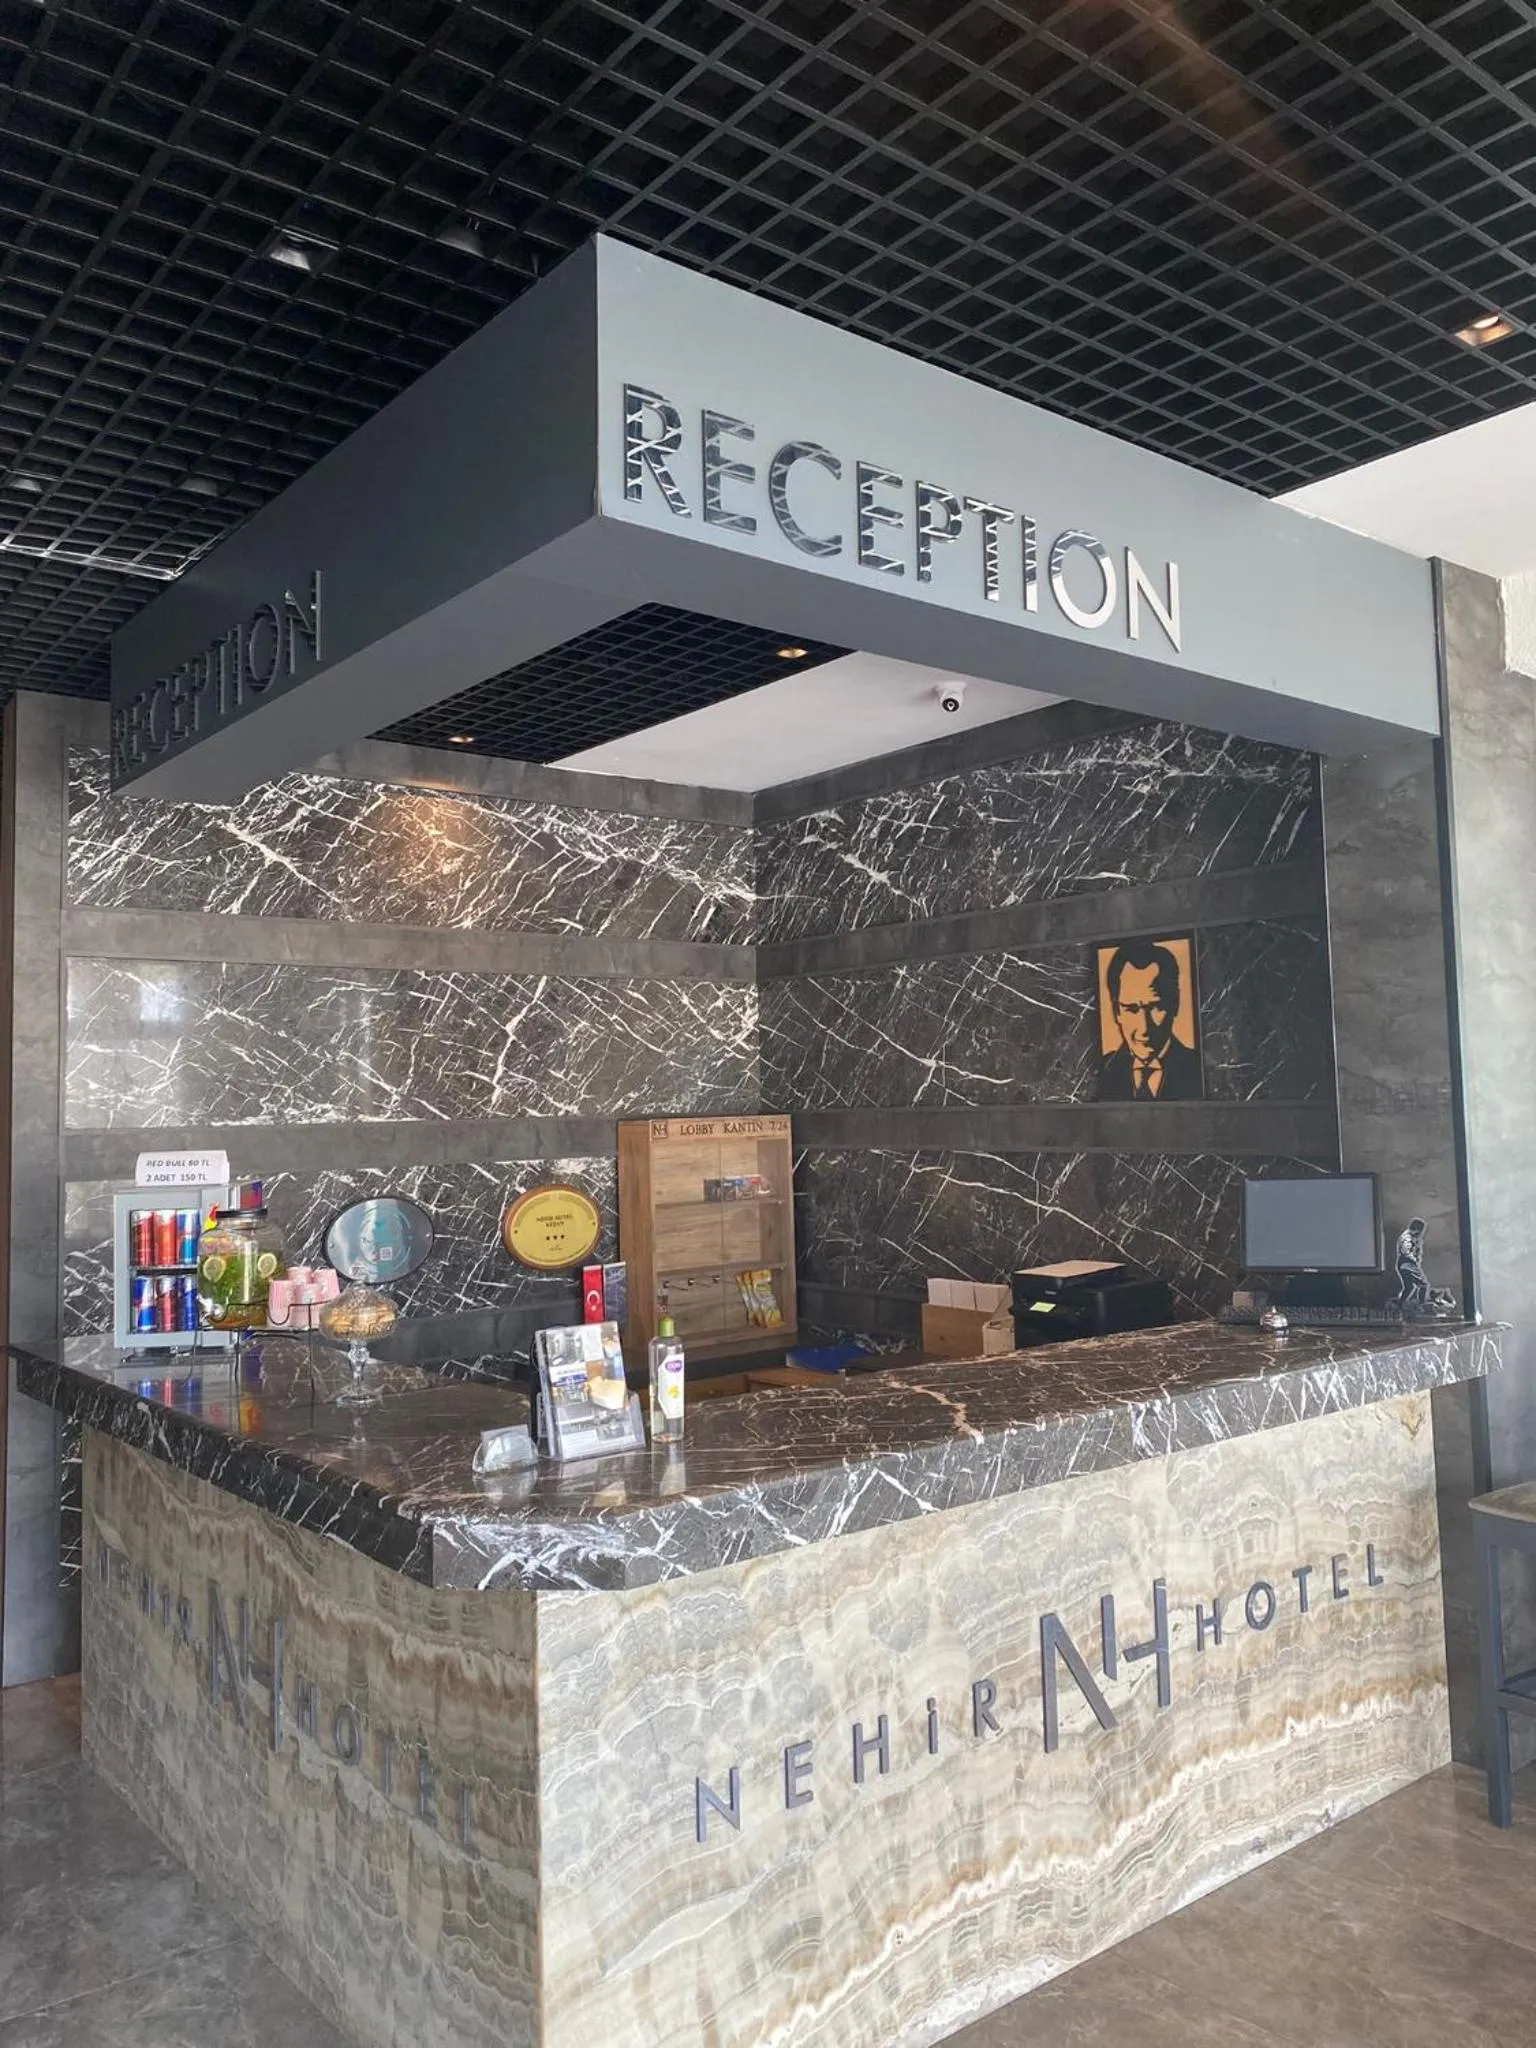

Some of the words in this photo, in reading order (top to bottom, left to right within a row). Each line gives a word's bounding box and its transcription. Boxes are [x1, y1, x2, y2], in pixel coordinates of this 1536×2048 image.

[622, 382, 1183, 655] RECEPTION
[109, 569, 322, 778] RECEPTION
[679, 1123, 715, 1136] LOBBY
[153, 1174, 177, 1182] ADET
[180, 1173, 196, 1181] 150
[165, 1159, 186, 1167] BULL
[1195, 1543, 1385, 1652] HOTEL
